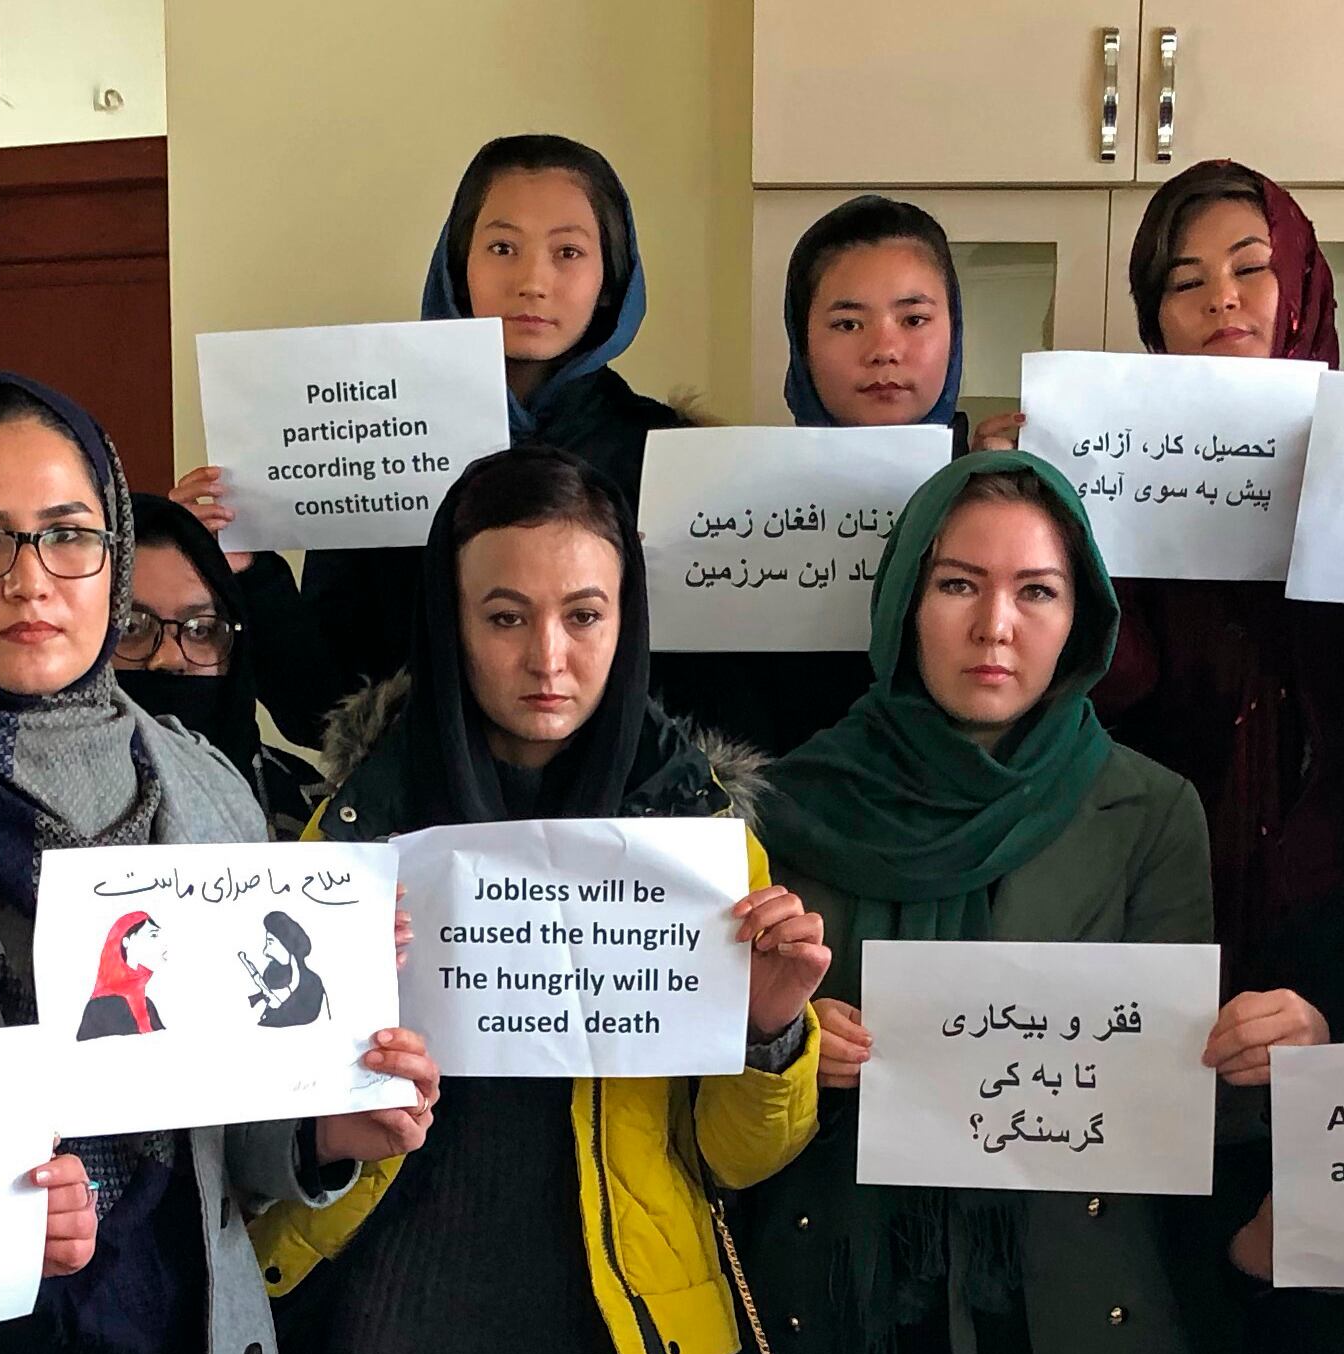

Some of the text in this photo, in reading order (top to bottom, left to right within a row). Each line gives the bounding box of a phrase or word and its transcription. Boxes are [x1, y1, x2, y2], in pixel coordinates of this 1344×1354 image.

[306, 378, 397, 404] Political
[282, 416, 428, 448] participation
[1072, 428, 1276, 463] تحصیل، کار، آزادی
[267, 451, 450, 481] according to the
[294, 491, 429, 516] constitution
[1134, 484, 1188, 504] سوی
[1195, 480, 1218, 506] به
[1225, 479, 1272, 513] پیش
[689, 503, 896, 539] زنان افغان زمین
[685, 558, 788, 589] سرزمین
[798, 557, 836, 590] این
[93, 867, 360, 906] سلاح ما صدای ماست
[474, 877, 666, 903] Jobless will be
[439, 920, 701, 952] caused the hungrily
[438, 965, 699, 997] The hungrily will be
[477, 1009, 660, 1034] caused death
[942, 1001, 1142, 1042] فقر و بیکاری
[979, 1061, 1097, 1099] تا به کی
[969, 1108, 1105, 1154] گرسنگی؟
